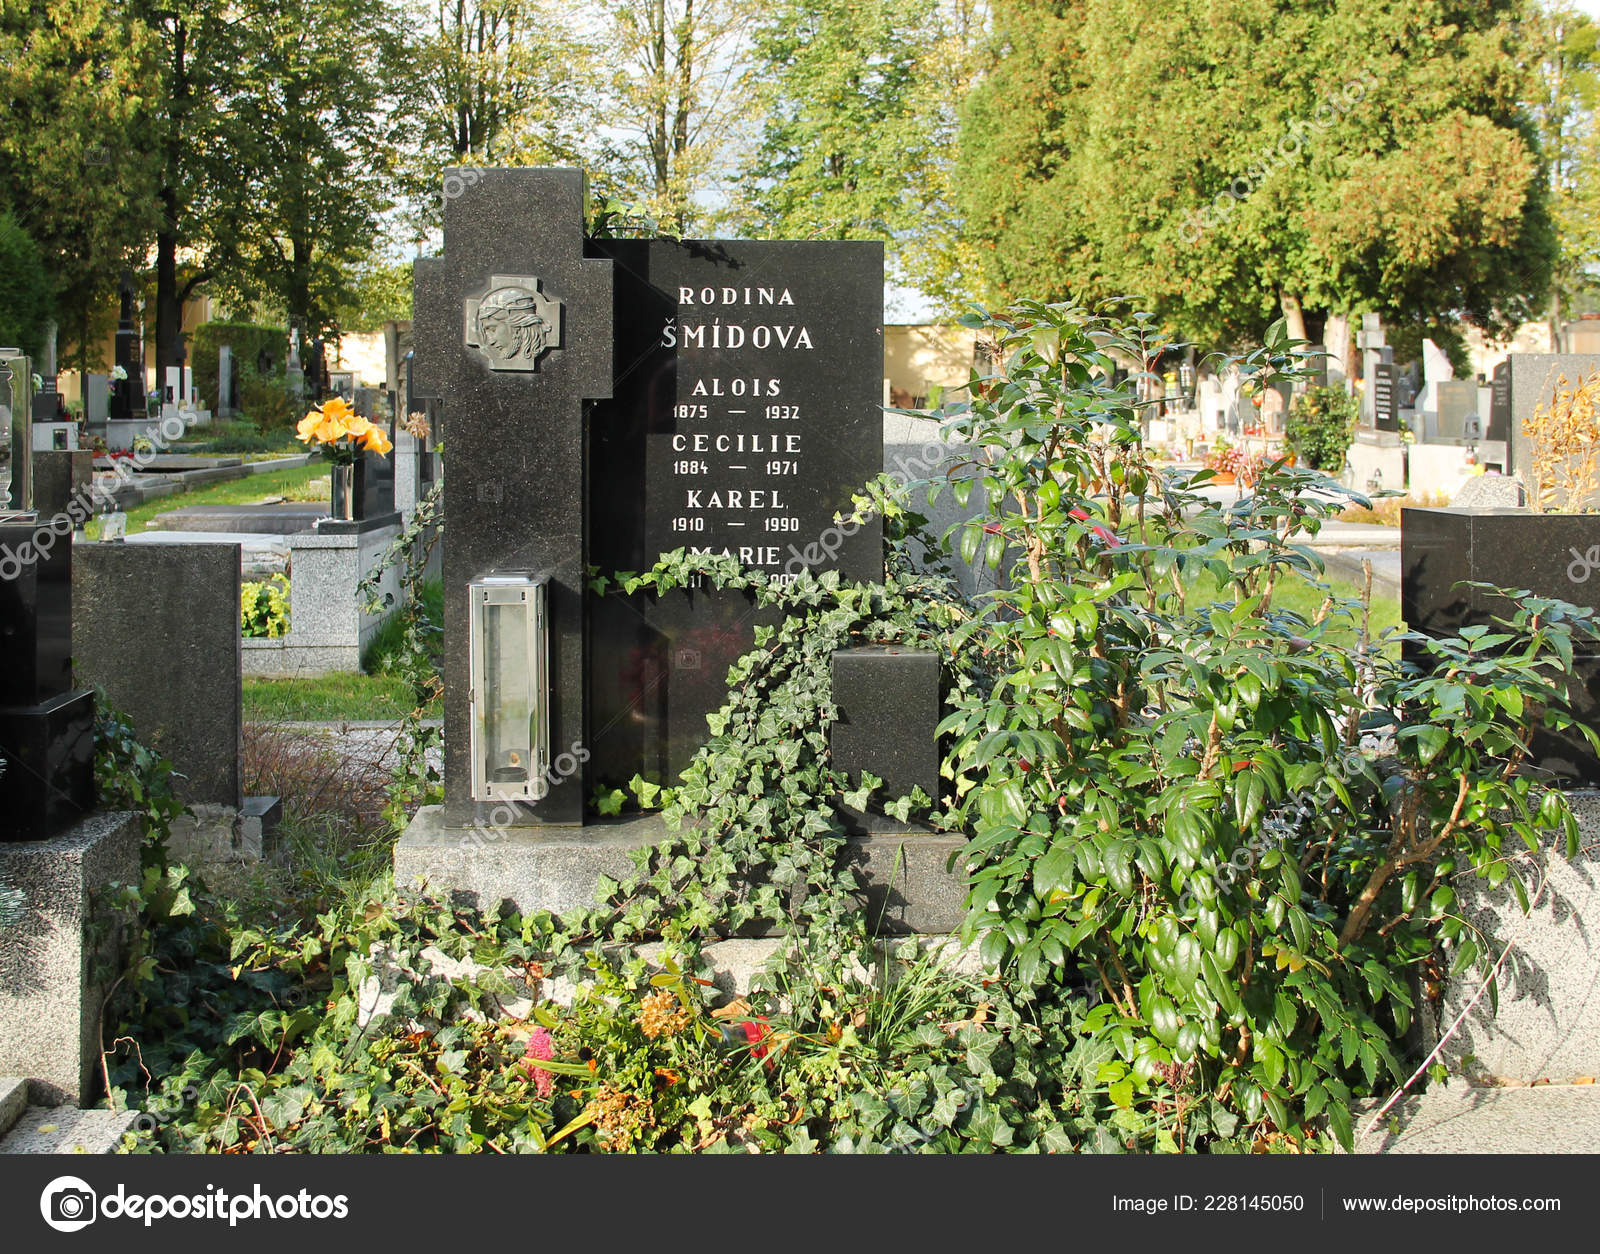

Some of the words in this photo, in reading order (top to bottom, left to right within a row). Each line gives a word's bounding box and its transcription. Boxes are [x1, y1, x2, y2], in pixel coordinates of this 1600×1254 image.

[679, 287, 795, 305] RODINA
[660, 317, 814, 350] ŠMÍDOVA
[691, 378, 781, 397] ALOIS
[673, 404, 708, 419] 1875
[765, 404, 799, 419] 1932
[672, 434, 801, 453] CECILIE
[673, 460, 708, 474] 1884
[766, 460, 798, 475] 1971
[687, 489, 785, 509] KAREL
[672, 517, 704, 532] 1910
[764, 517, 799, 532] 1990
